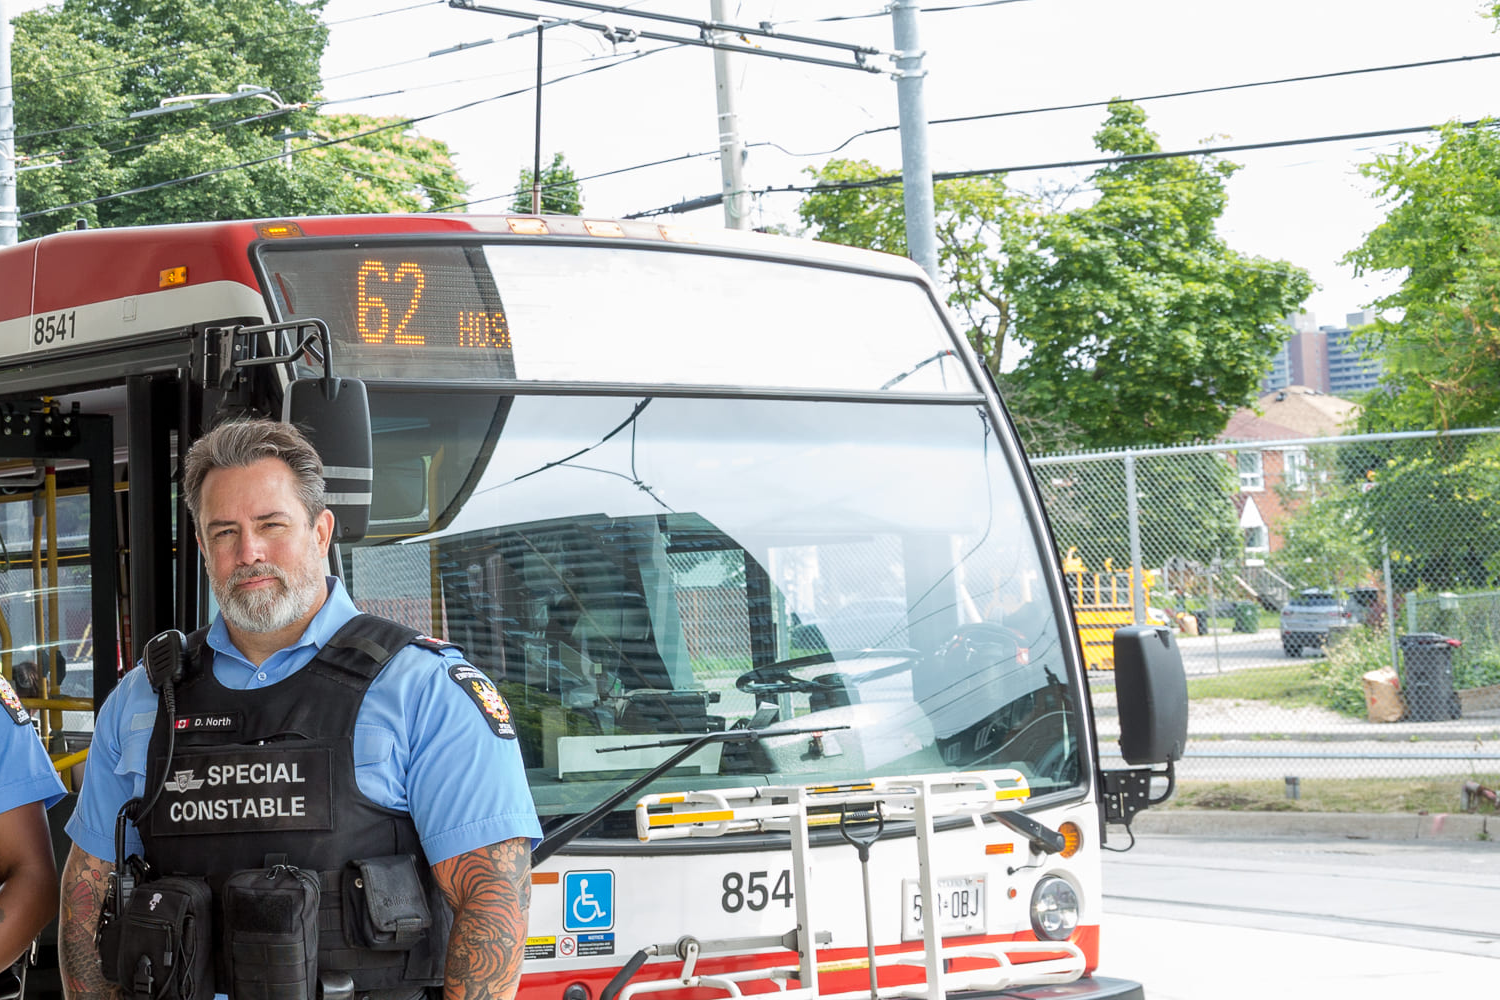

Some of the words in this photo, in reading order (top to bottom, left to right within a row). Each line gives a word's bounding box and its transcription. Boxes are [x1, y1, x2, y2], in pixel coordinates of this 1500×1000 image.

[358, 260, 425, 344] 62
[459, 311, 512, 348] HOS
[34, 310, 76, 346] 8541
[194, 718, 204, 727] D.
[206, 717, 232, 727] North
[207, 763, 306, 786] SPECIAL
[170, 796, 306, 822] CONSTABLE
[721, 869, 794, 914] 854
